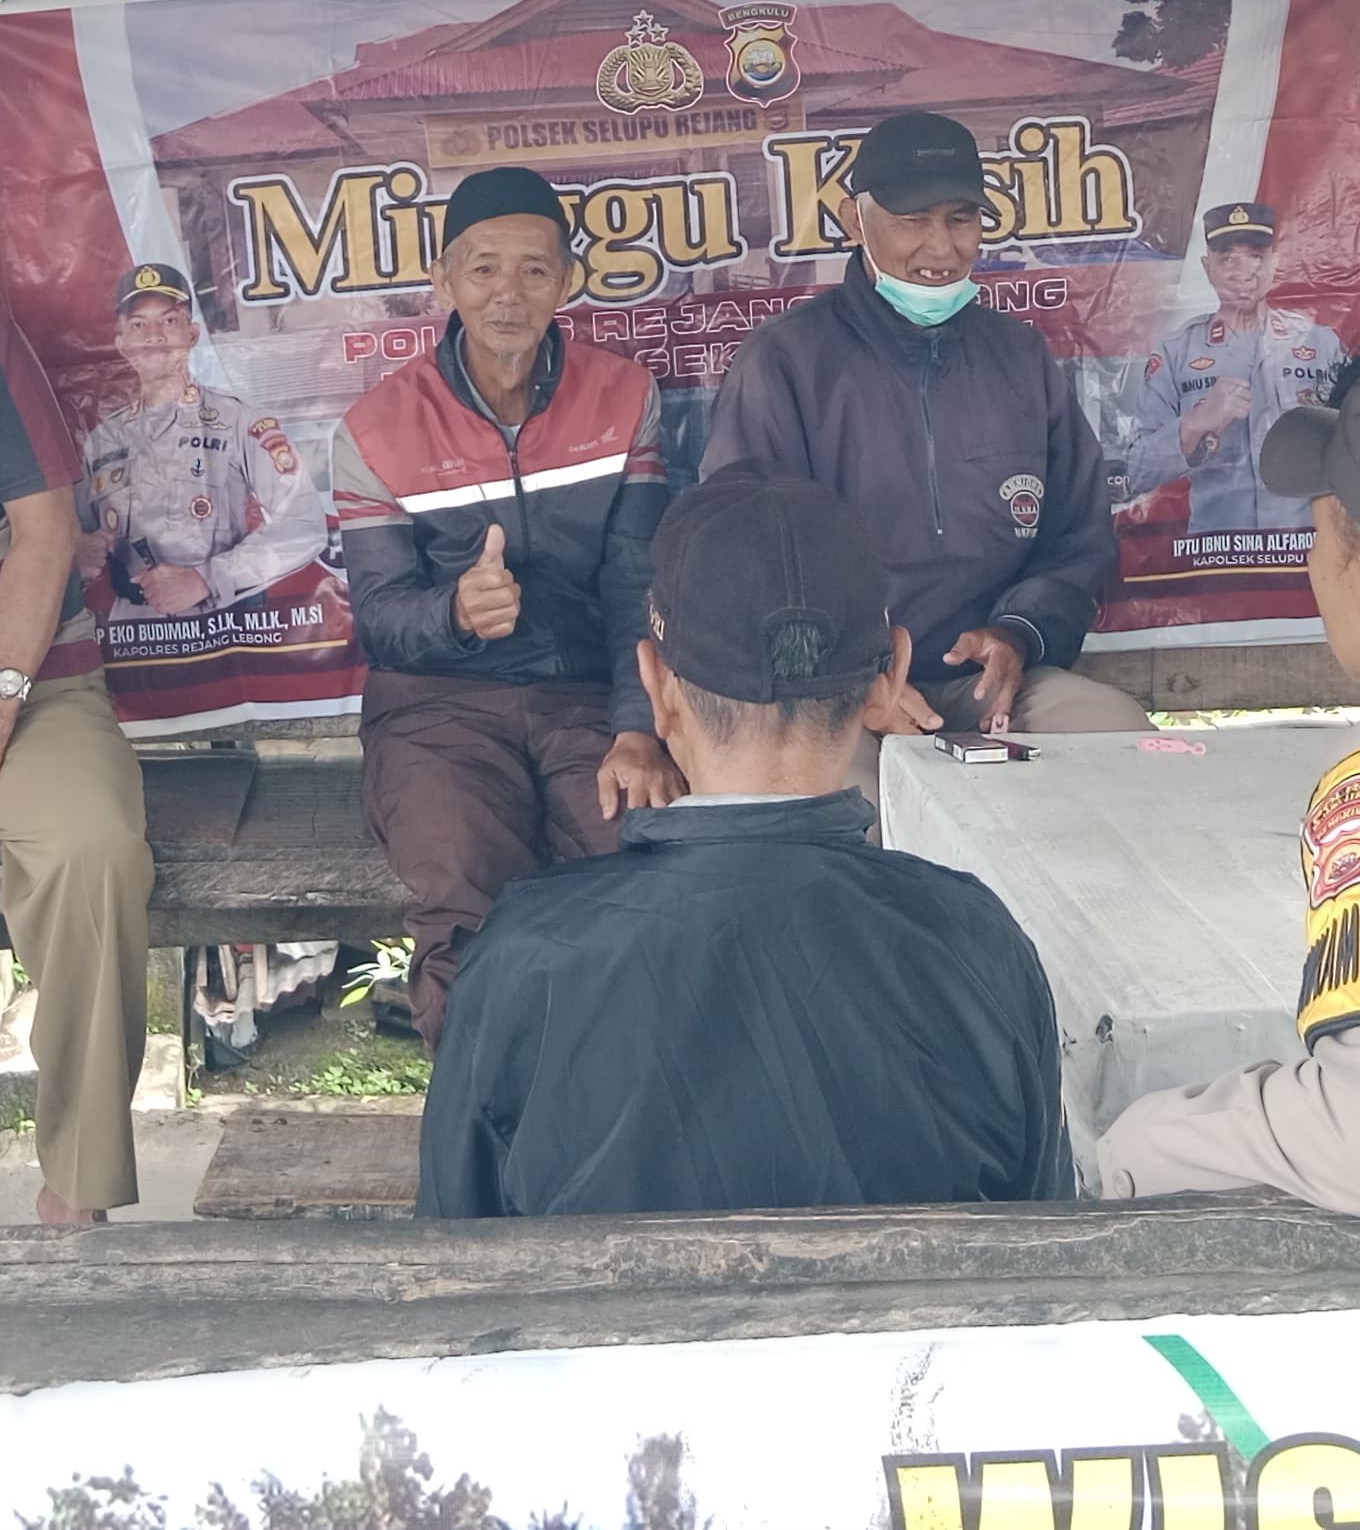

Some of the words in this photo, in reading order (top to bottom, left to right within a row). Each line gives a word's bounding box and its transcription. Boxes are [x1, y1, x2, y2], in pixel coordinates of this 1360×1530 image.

[488, 119, 579, 151] POLSEK
[584, 113, 668, 144] SELUPU
[676, 108, 758, 137] REJANG
[233, 170, 743, 302] Migu
[768, 122, 1140, 258] Ksih
[178, 436, 228, 452] POLRI
[1173, 538, 1201, 558] IPTU
[1202, 535, 1231, 553] IBNU
[1233, 534, 1264, 552] SINA
[1193, 555, 1254, 567] KAPOLSEK
[1257, 553, 1304, 564] SELUPU
[109, 624, 135, 645] EKO
[138, 619, 205, 642] BUDIMAN,
[113, 643, 179, 658] KAPOLRES
[181, 634, 230, 654] REJANG
[232, 632, 282, 644] LEBONG
